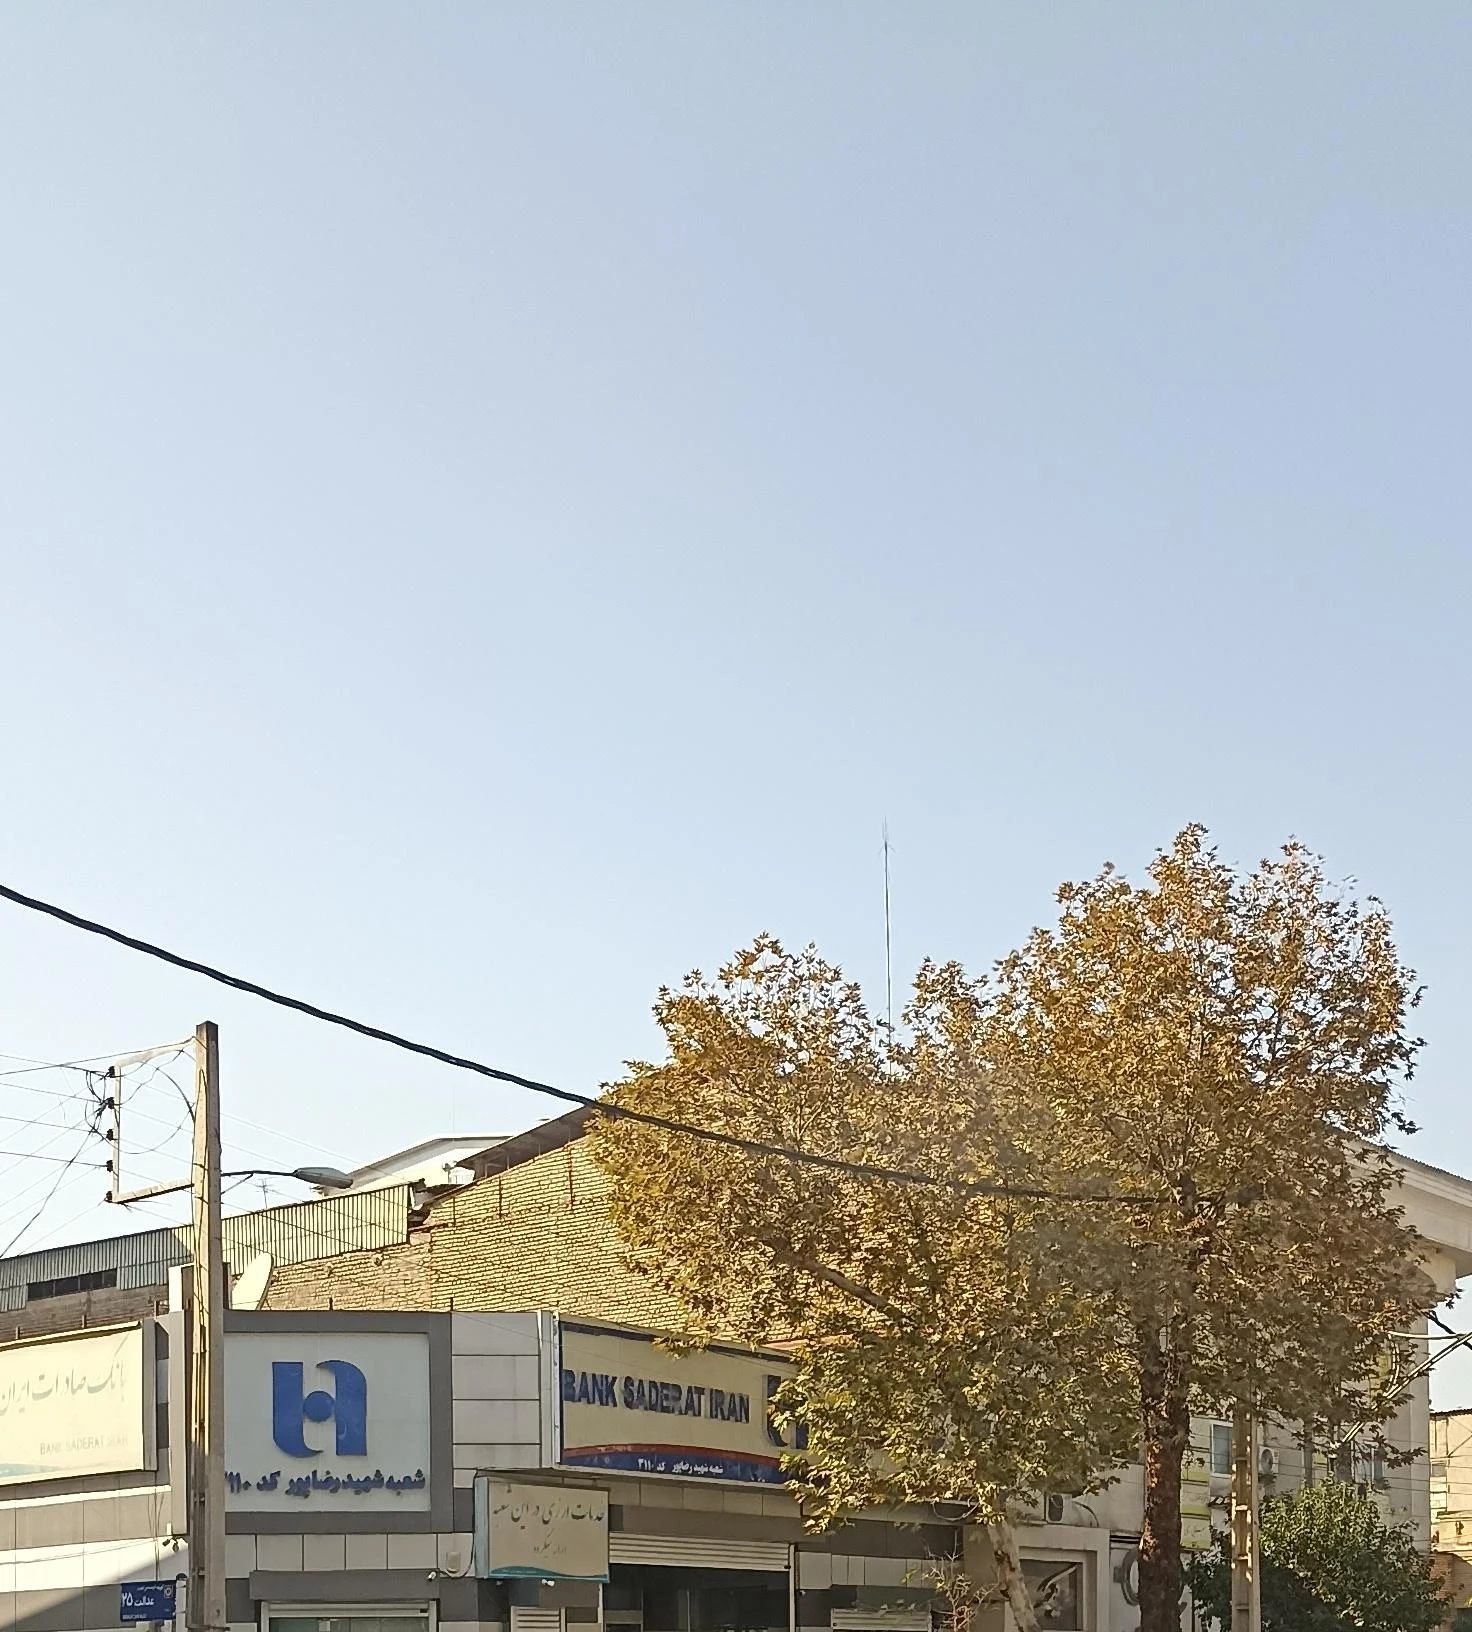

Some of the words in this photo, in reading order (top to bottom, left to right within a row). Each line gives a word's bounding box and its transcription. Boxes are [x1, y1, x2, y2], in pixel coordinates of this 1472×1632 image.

[87, 1333, 129, 1402] بانک
[32, 1367, 87, 1401] صادرات
[562, 1369, 617, 1407] BANK
[623, 1375, 705, 1417] SADERAT
[709, 1387, 750, 1424] IRAN
[637, 1458, 655, 1472] ۳۱۱۰
[656, 1462, 666, 1472] کد
[671, 1460, 693, 1475] رضاپور
[693, 1463, 709, 1475] شهید
[709, 1464, 724, 1475] شعبه
[256, 1470, 281, 1492] کد
[285, 1469, 342, 1499] رضاپور
[341, 1469, 385, 1496] شهید
[385, 1468, 426, 1497] شعبه
[511, 1503, 530, 1530] این
[121, 1591, 134, 1608] ۲۵
[134, 1595, 157, 1608] عدالت
